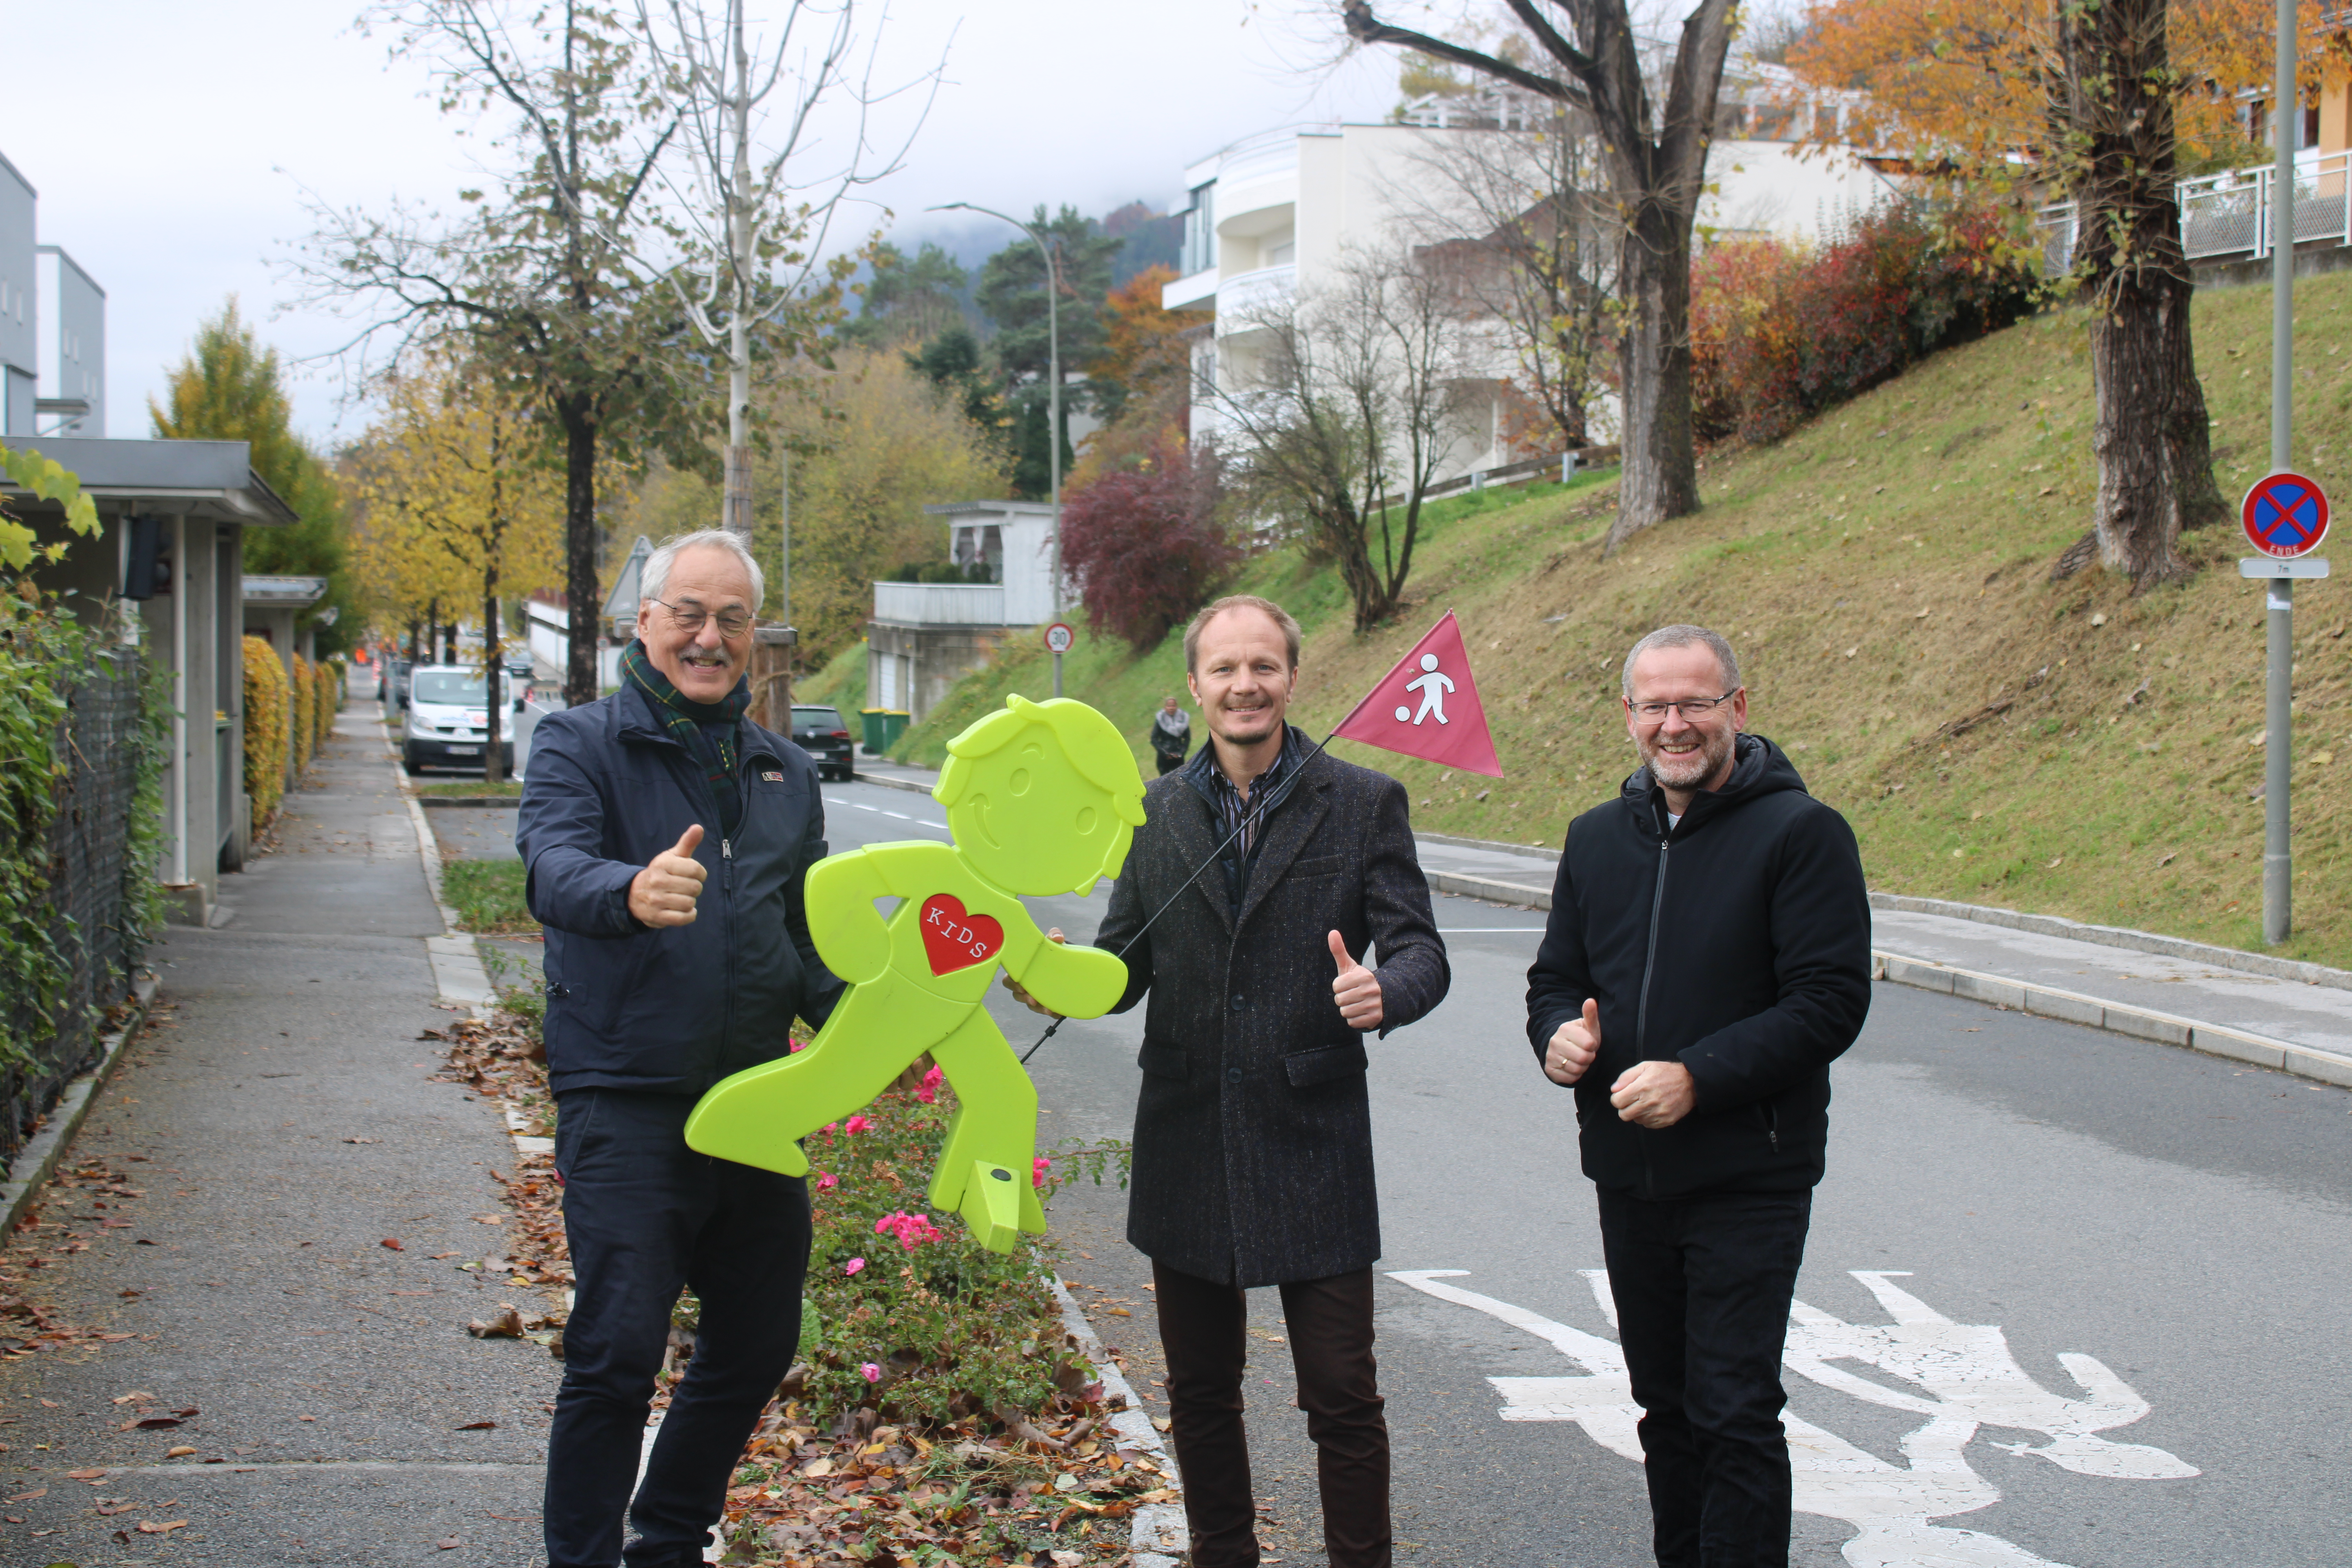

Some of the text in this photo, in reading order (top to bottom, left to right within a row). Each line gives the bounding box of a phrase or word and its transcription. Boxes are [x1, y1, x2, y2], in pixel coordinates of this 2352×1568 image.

[2269, 545, 2299, 556] ENDE
[1052, 632, 1067, 645] 30
[926, 907, 987, 958] KIDS
